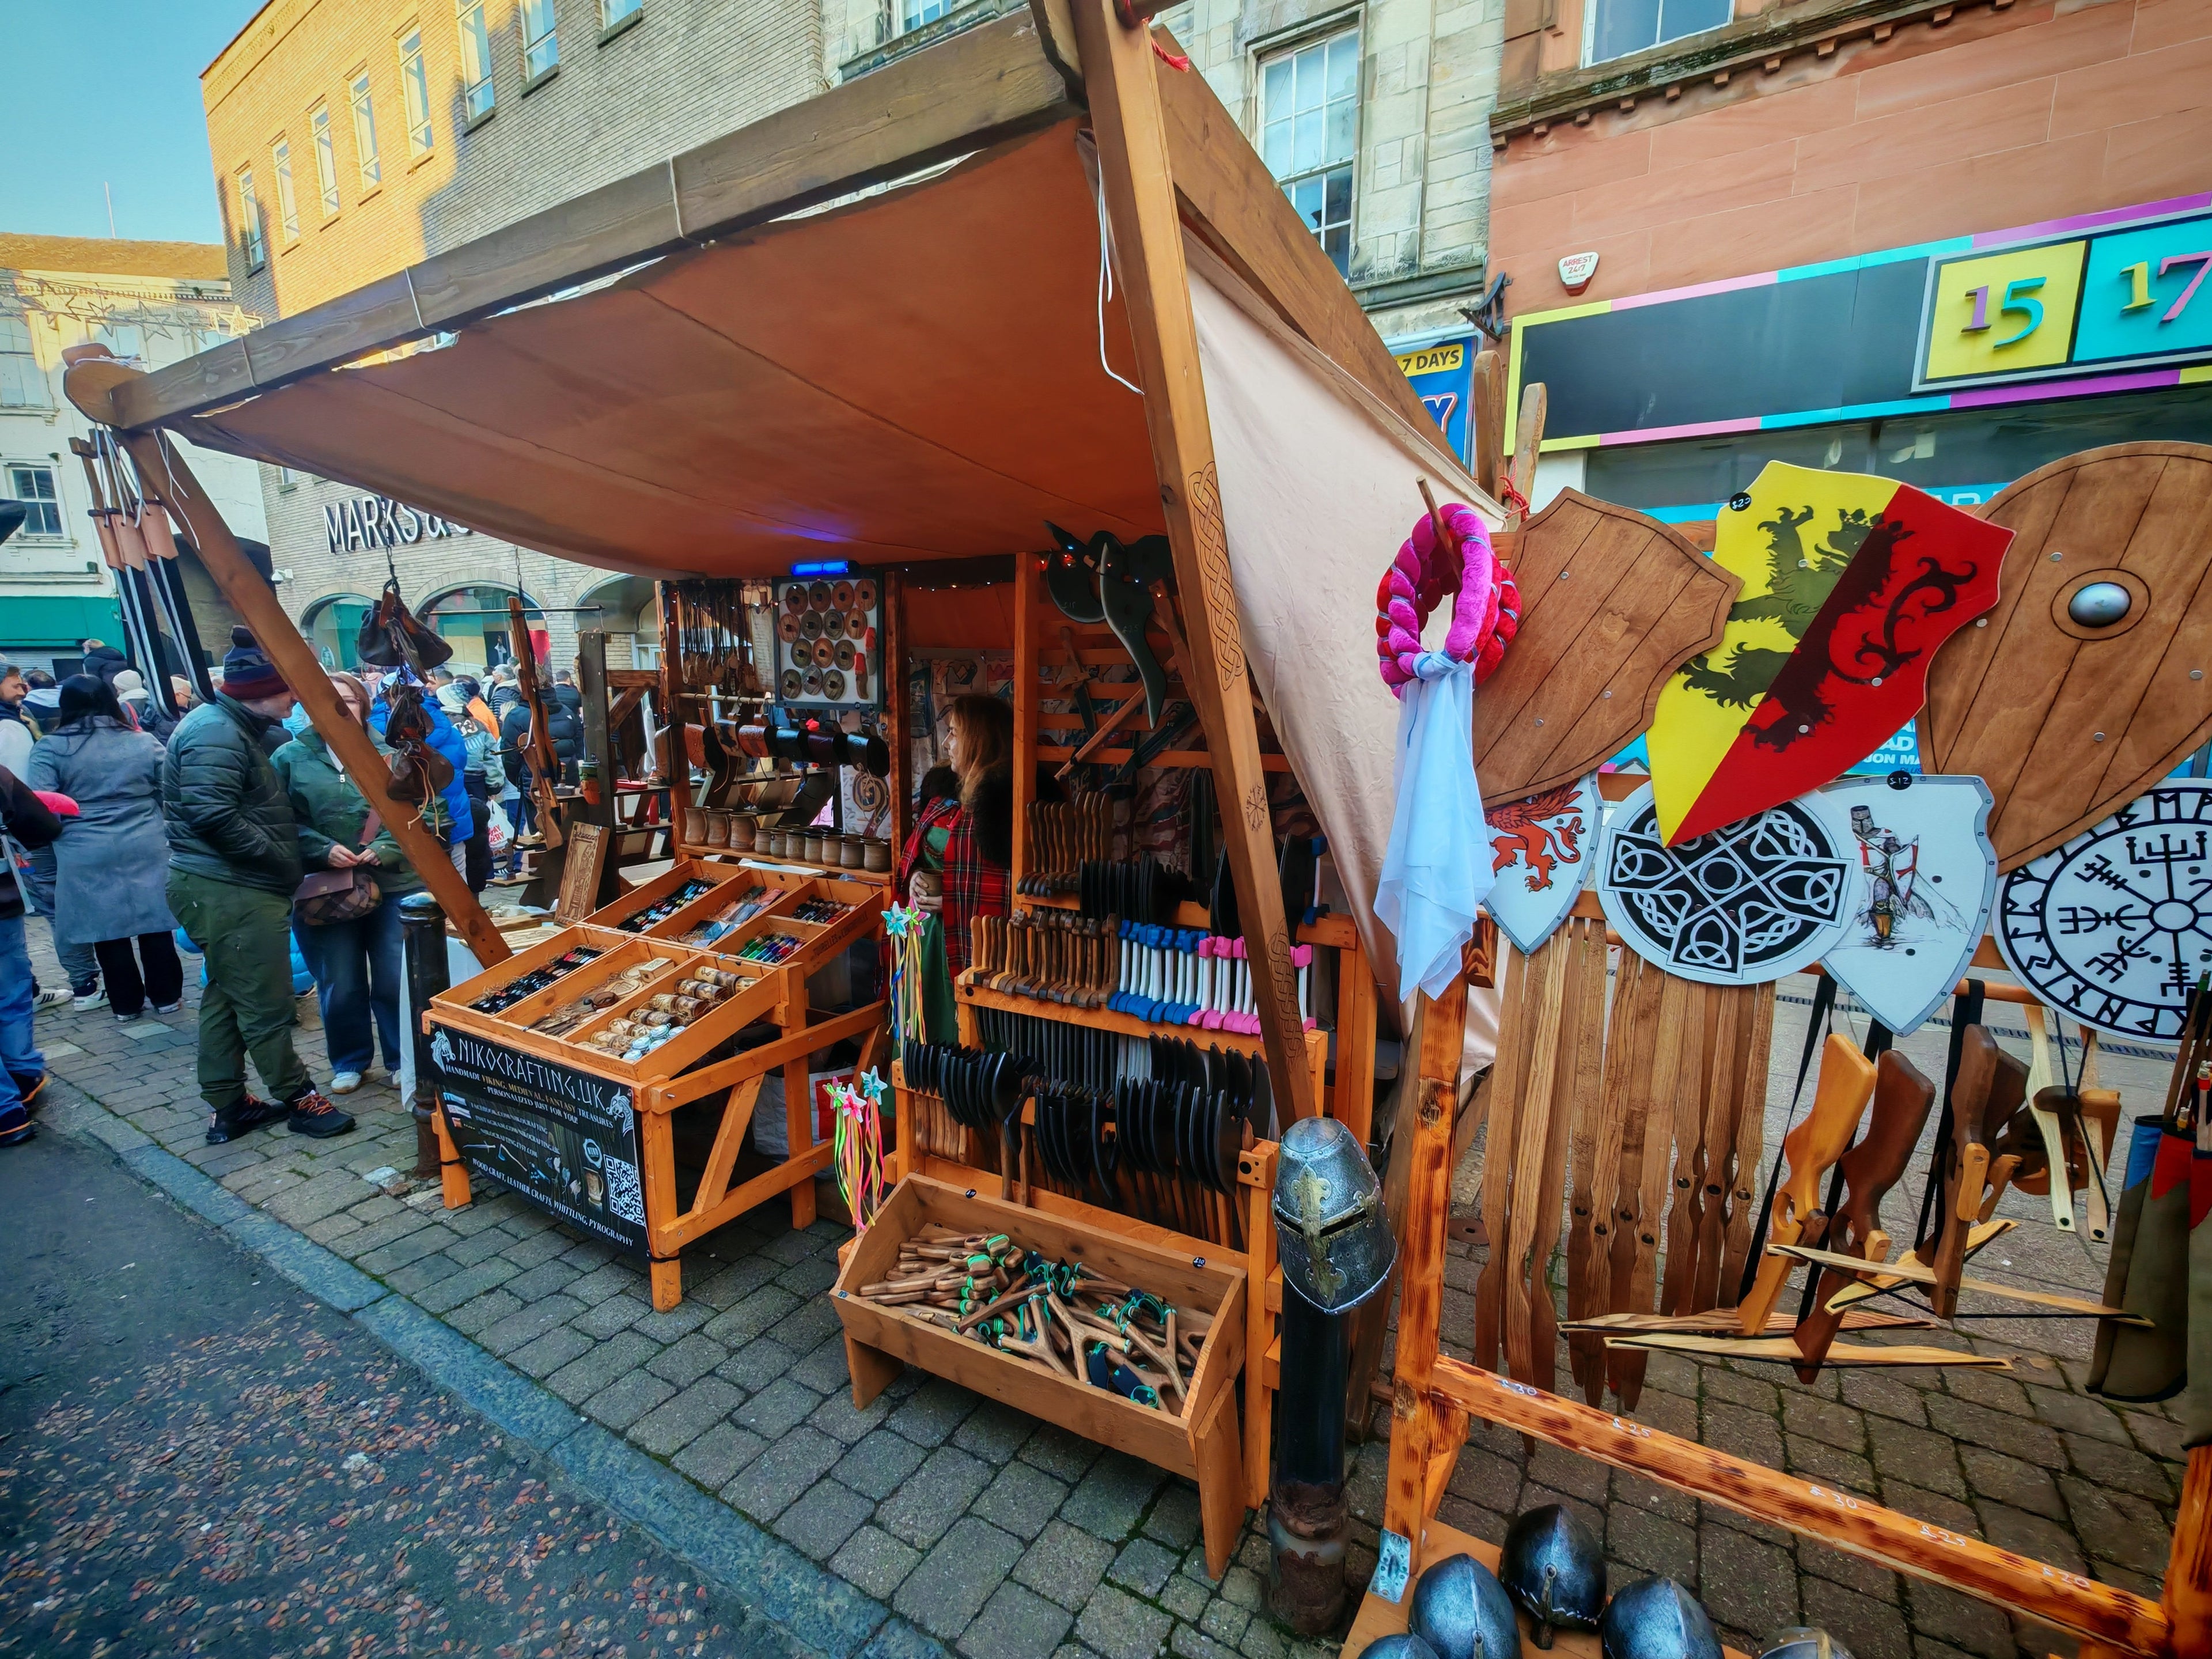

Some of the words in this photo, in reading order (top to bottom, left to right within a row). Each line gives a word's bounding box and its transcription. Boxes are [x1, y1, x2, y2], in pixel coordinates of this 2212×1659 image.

[1562, 255, 1594, 268] ARREST
[1960, 276, 2047, 349] 15
[2119, 250, 2212, 324] 17
[1403, 358, 1412, 373] 7
[1416, 349, 1460, 370] DAYS
[323, 495, 421, 554] MARKS
[445, 1064, 481, 1081] HANDMADE
[546, 1095, 575, 1113] FANTASY
[577, 1108, 613, 1128] TREASURES
[459, 1037, 605, 1112] NIKOCRAFTING.UK
[487, 1086, 533, 1106] PERSONALIZED
[534, 1101, 548, 1111] JUST
[550, 1106, 563, 1118] FOR
[472, 1158, 488, 1172] WOOD
[488, 1167, 506, 1183] CRAFT,
[507, 1176, 530, 1195] LEATHER
[589, 1218, 634, 1247] PYROGRAPHY
